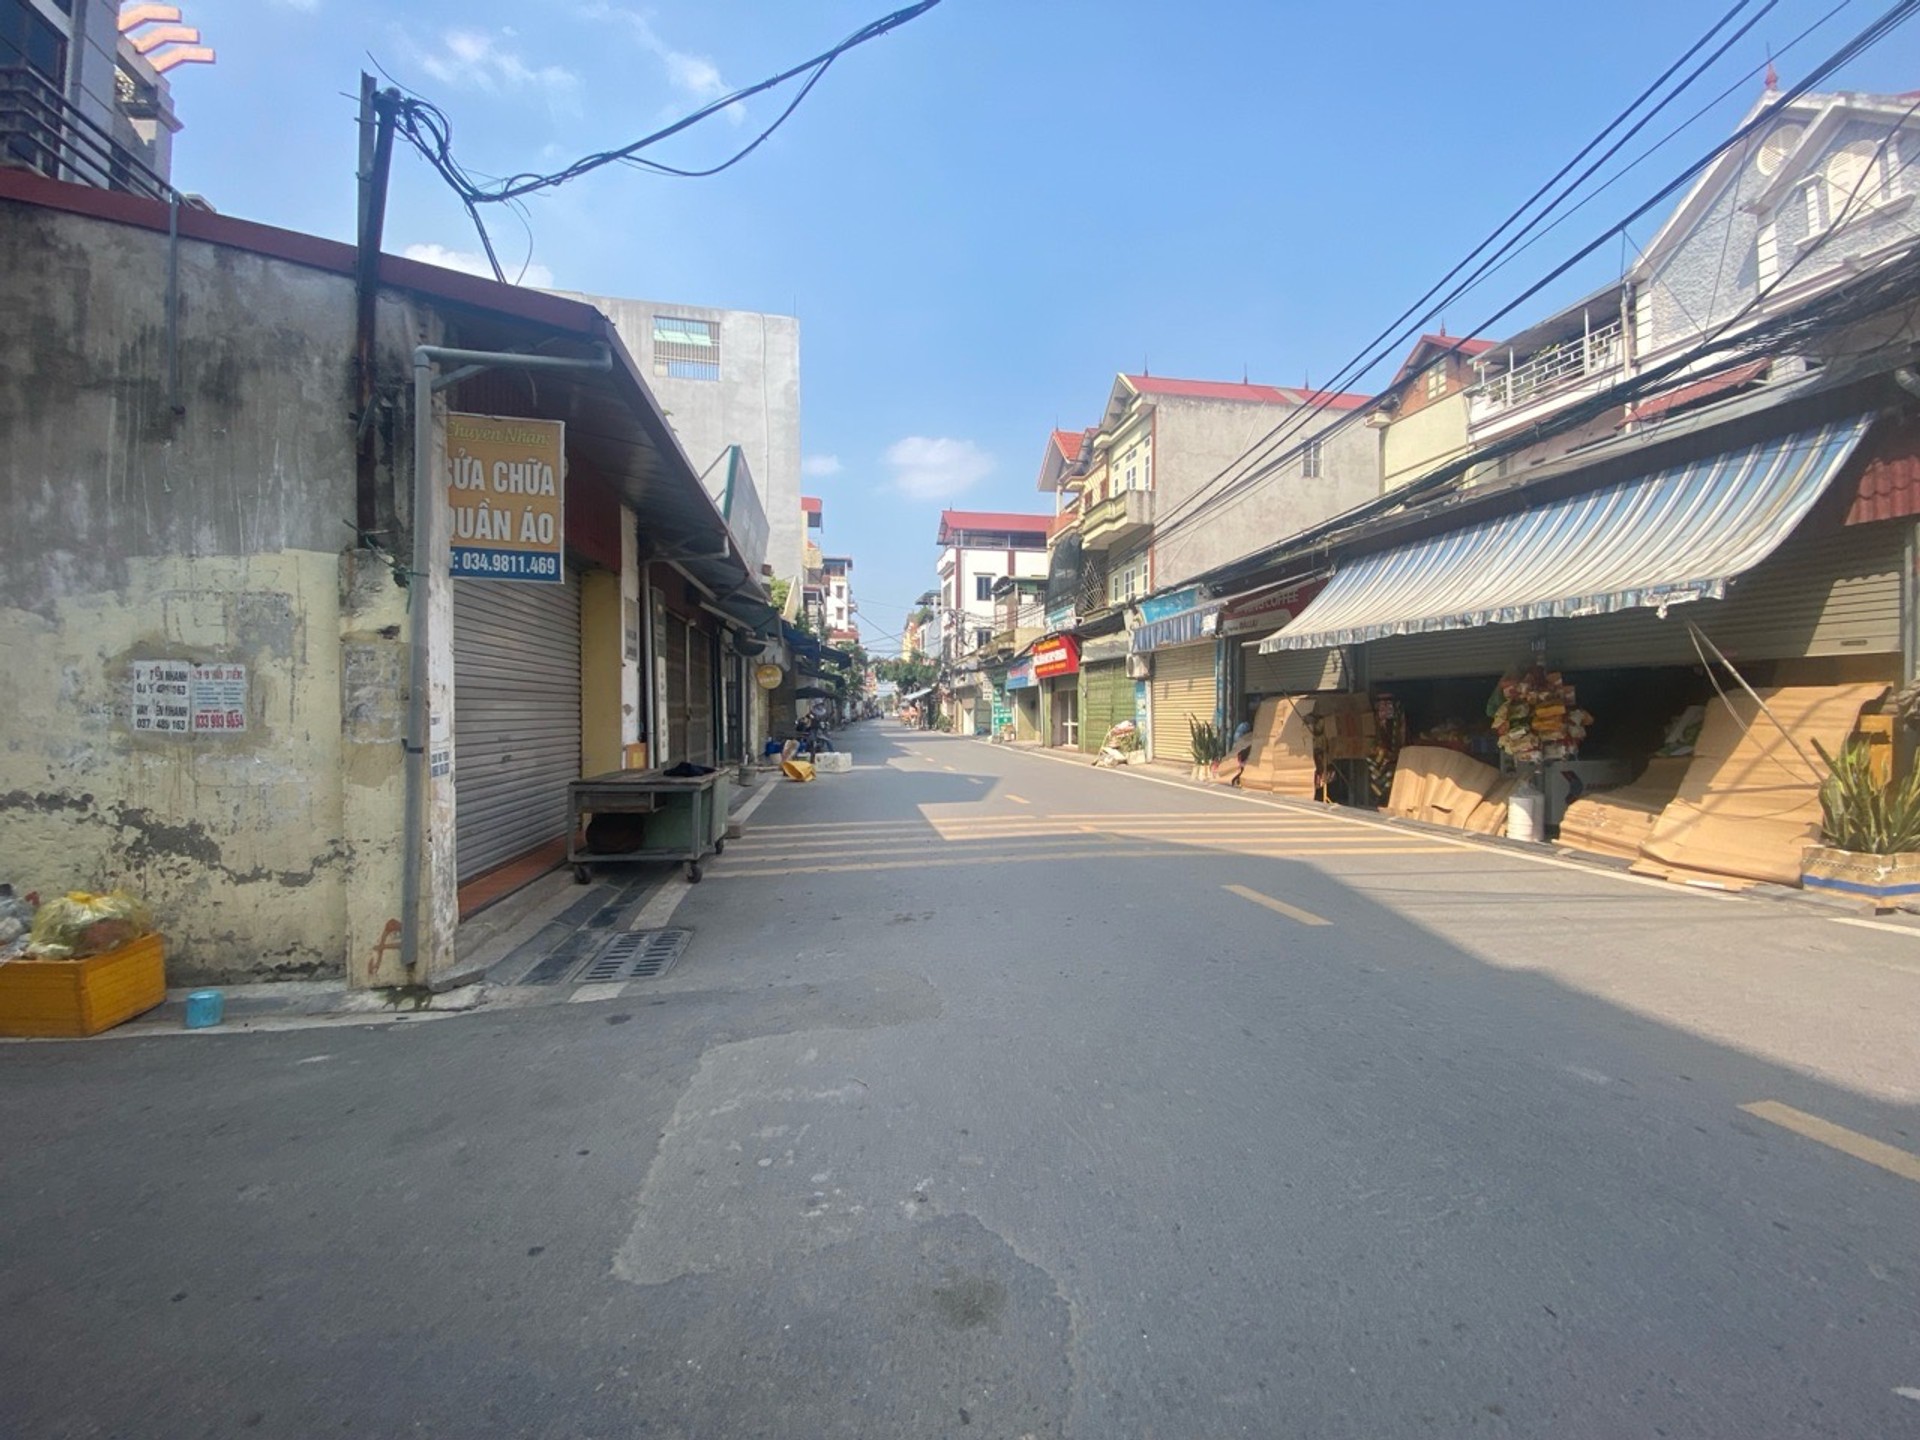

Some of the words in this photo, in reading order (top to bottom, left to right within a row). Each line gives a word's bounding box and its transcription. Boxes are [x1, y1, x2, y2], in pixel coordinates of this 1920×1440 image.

[493, 457, 555, 497] CHỮA
[519, 506, 554, 544] ÁO
[462, 551, 556, 575] 034.9811.469
